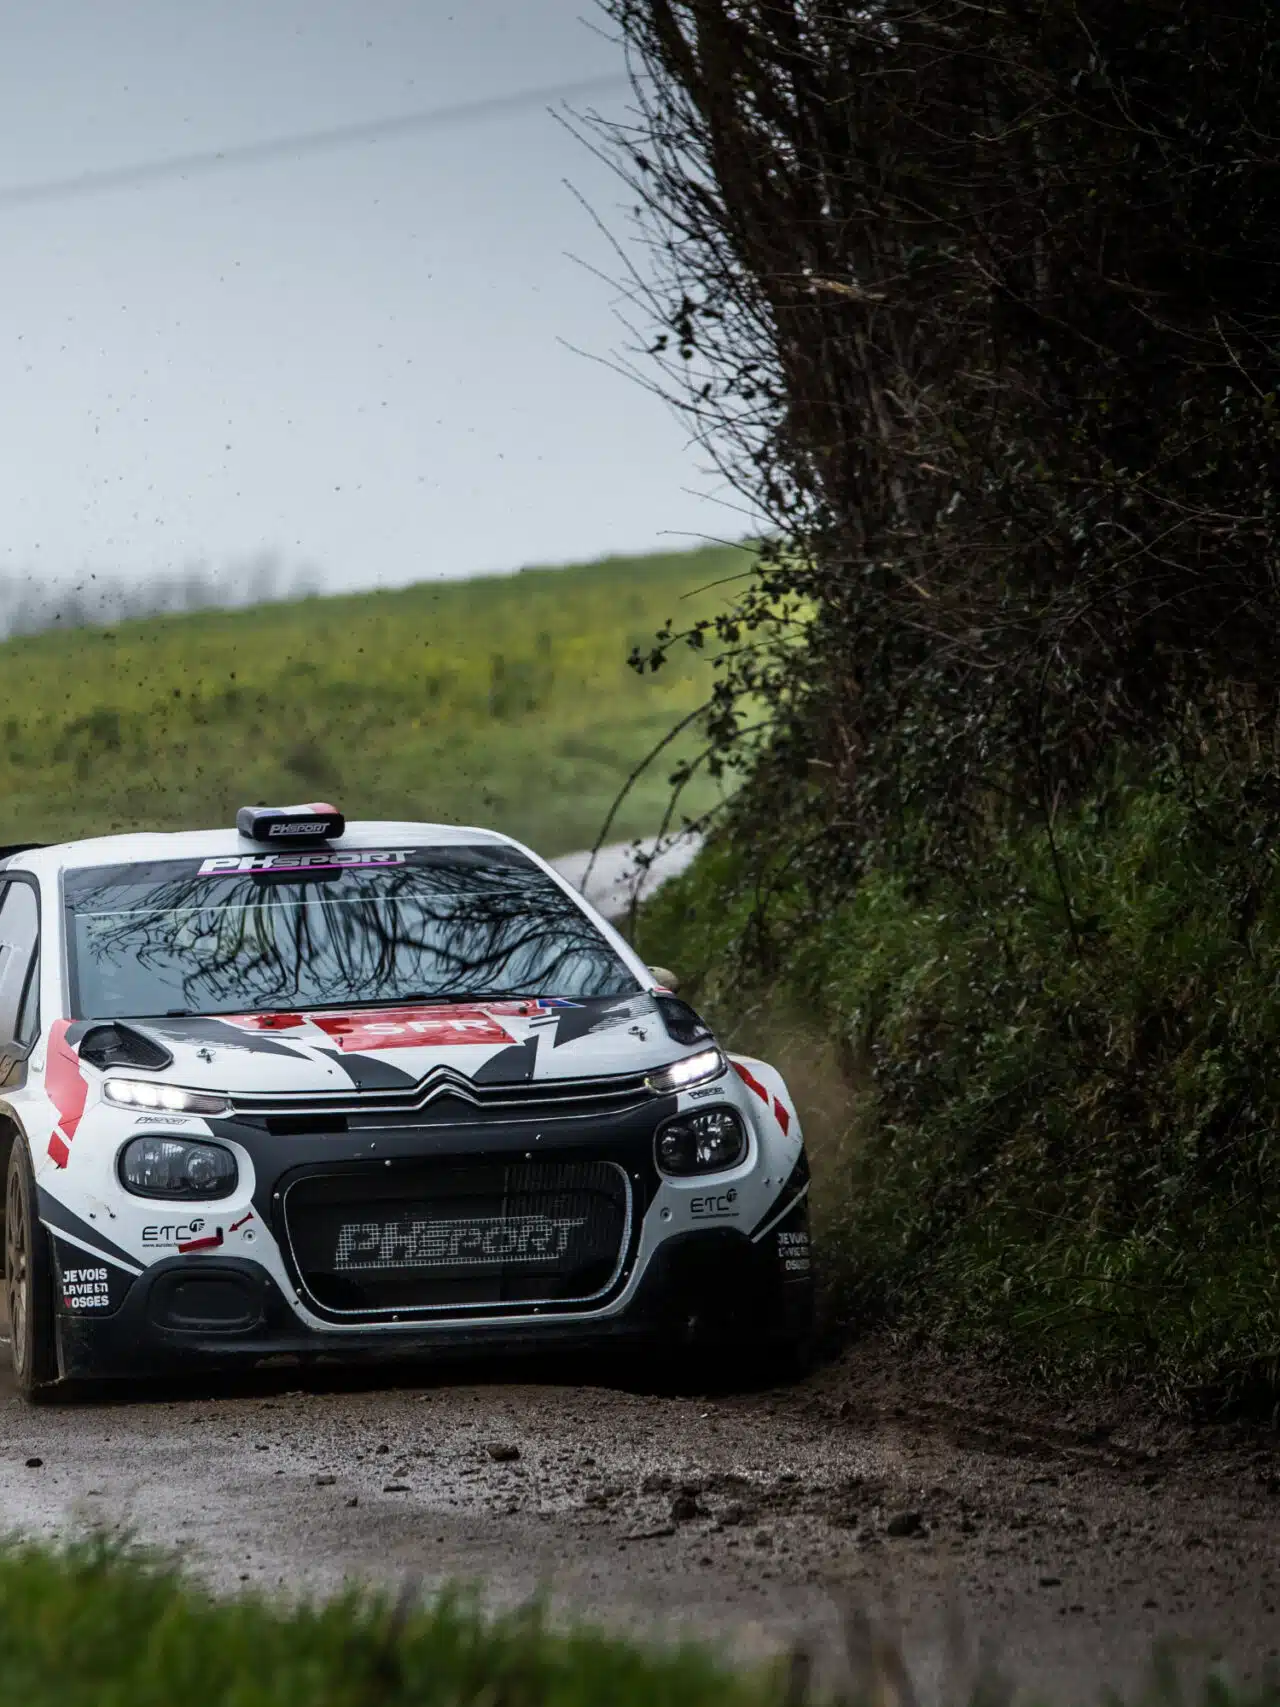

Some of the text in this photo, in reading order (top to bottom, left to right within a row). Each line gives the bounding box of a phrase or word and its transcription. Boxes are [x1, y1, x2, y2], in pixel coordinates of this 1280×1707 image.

[269, 822, 331, 836] PHSPORT
[198, 849, 417, 874] PHSPORT
[362, 1018, 494, 1036] SFR
[691, 1196, 730, 1213] ETC
[141, 1225, 192, 1241] ETC
[334, 1216, 588, 1266] PHSPORT
[62, 1268, 108, 1283] JE VOIS
[76, 1283, 93, 1295] VIE
[63, 1295, 110, 1309] VOSGES
